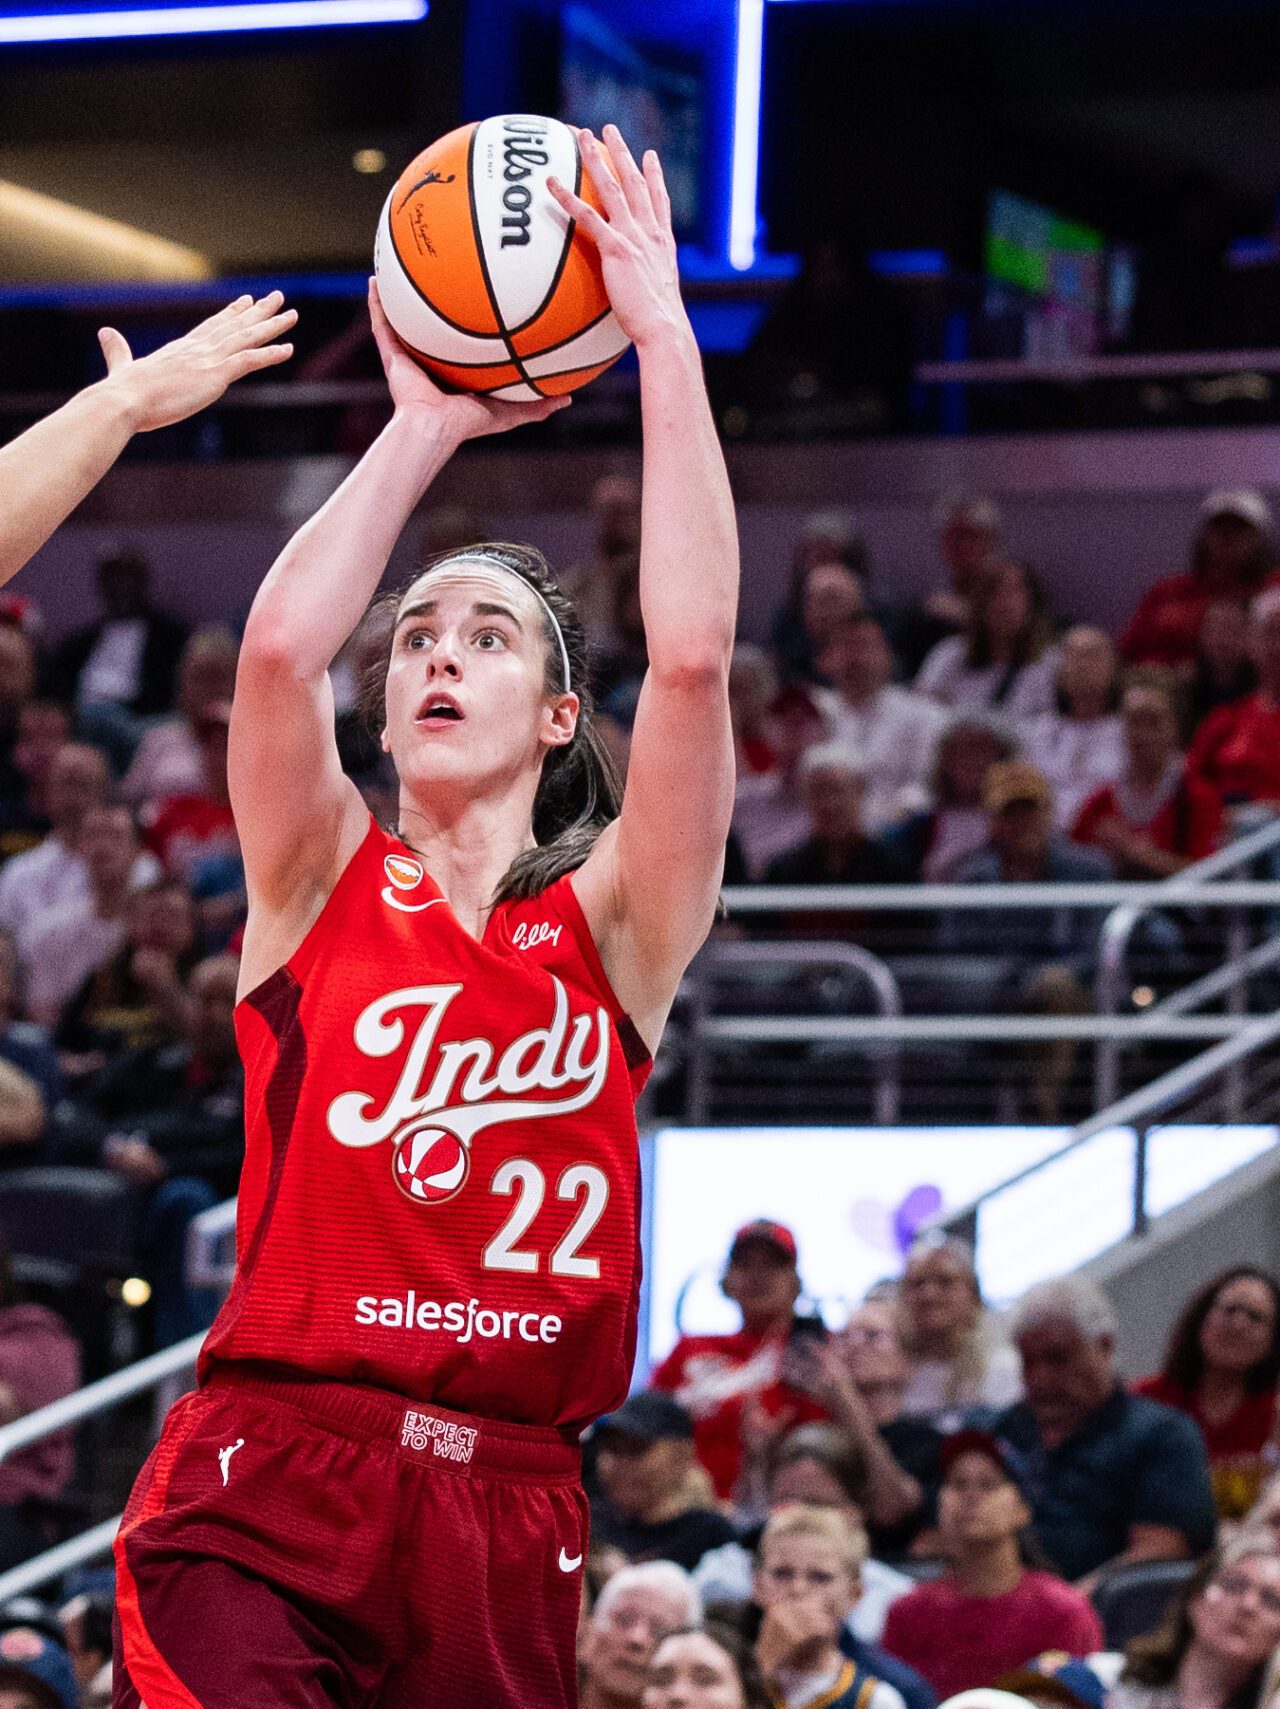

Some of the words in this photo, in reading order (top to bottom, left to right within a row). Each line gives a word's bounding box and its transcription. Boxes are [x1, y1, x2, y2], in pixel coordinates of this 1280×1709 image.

[327, 974, 611, 1149] Indy
[481, 1157, 610, 1279] 22
[354, 1290, 563, 1344] salesforce
[401, 1429, 428, 1450] TO
[433, 1438, 474, 1464] WIN
[403, 1410, 478, 1447] EXPECT
